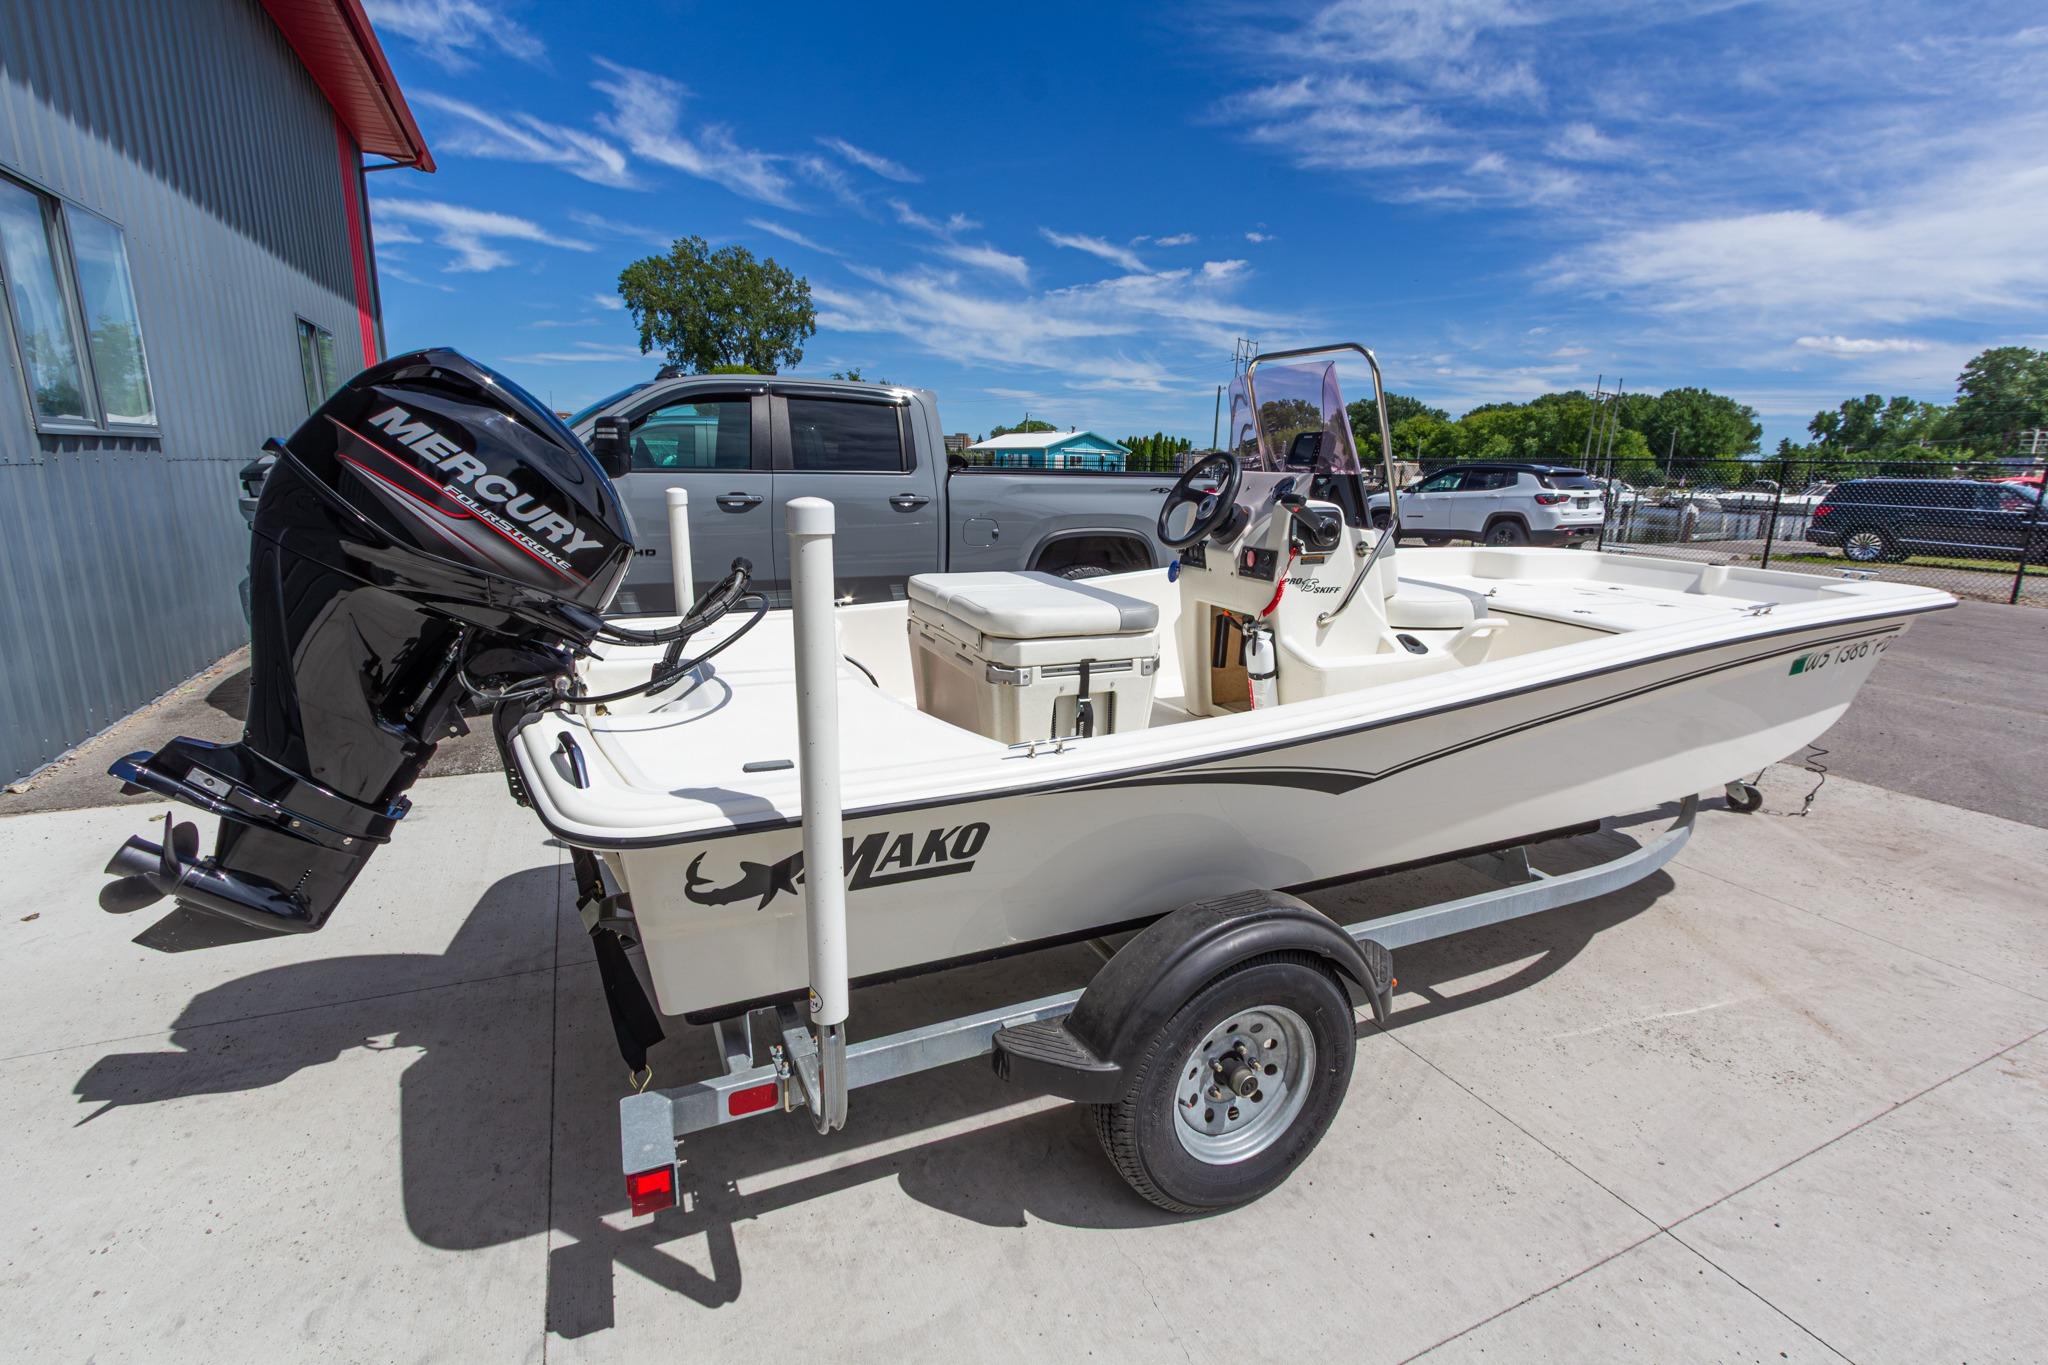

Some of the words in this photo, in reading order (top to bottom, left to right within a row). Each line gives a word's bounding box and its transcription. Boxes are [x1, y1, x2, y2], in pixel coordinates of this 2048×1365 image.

[368, 406, 604, 555] MERCURY
[443, 485, 573, 570] FOURSTROKE
[1283, 577, 1303, 585] PRO
[1313, 586, 1341, 594] SKIFF
[838, 821, 991, 891] MAKO
